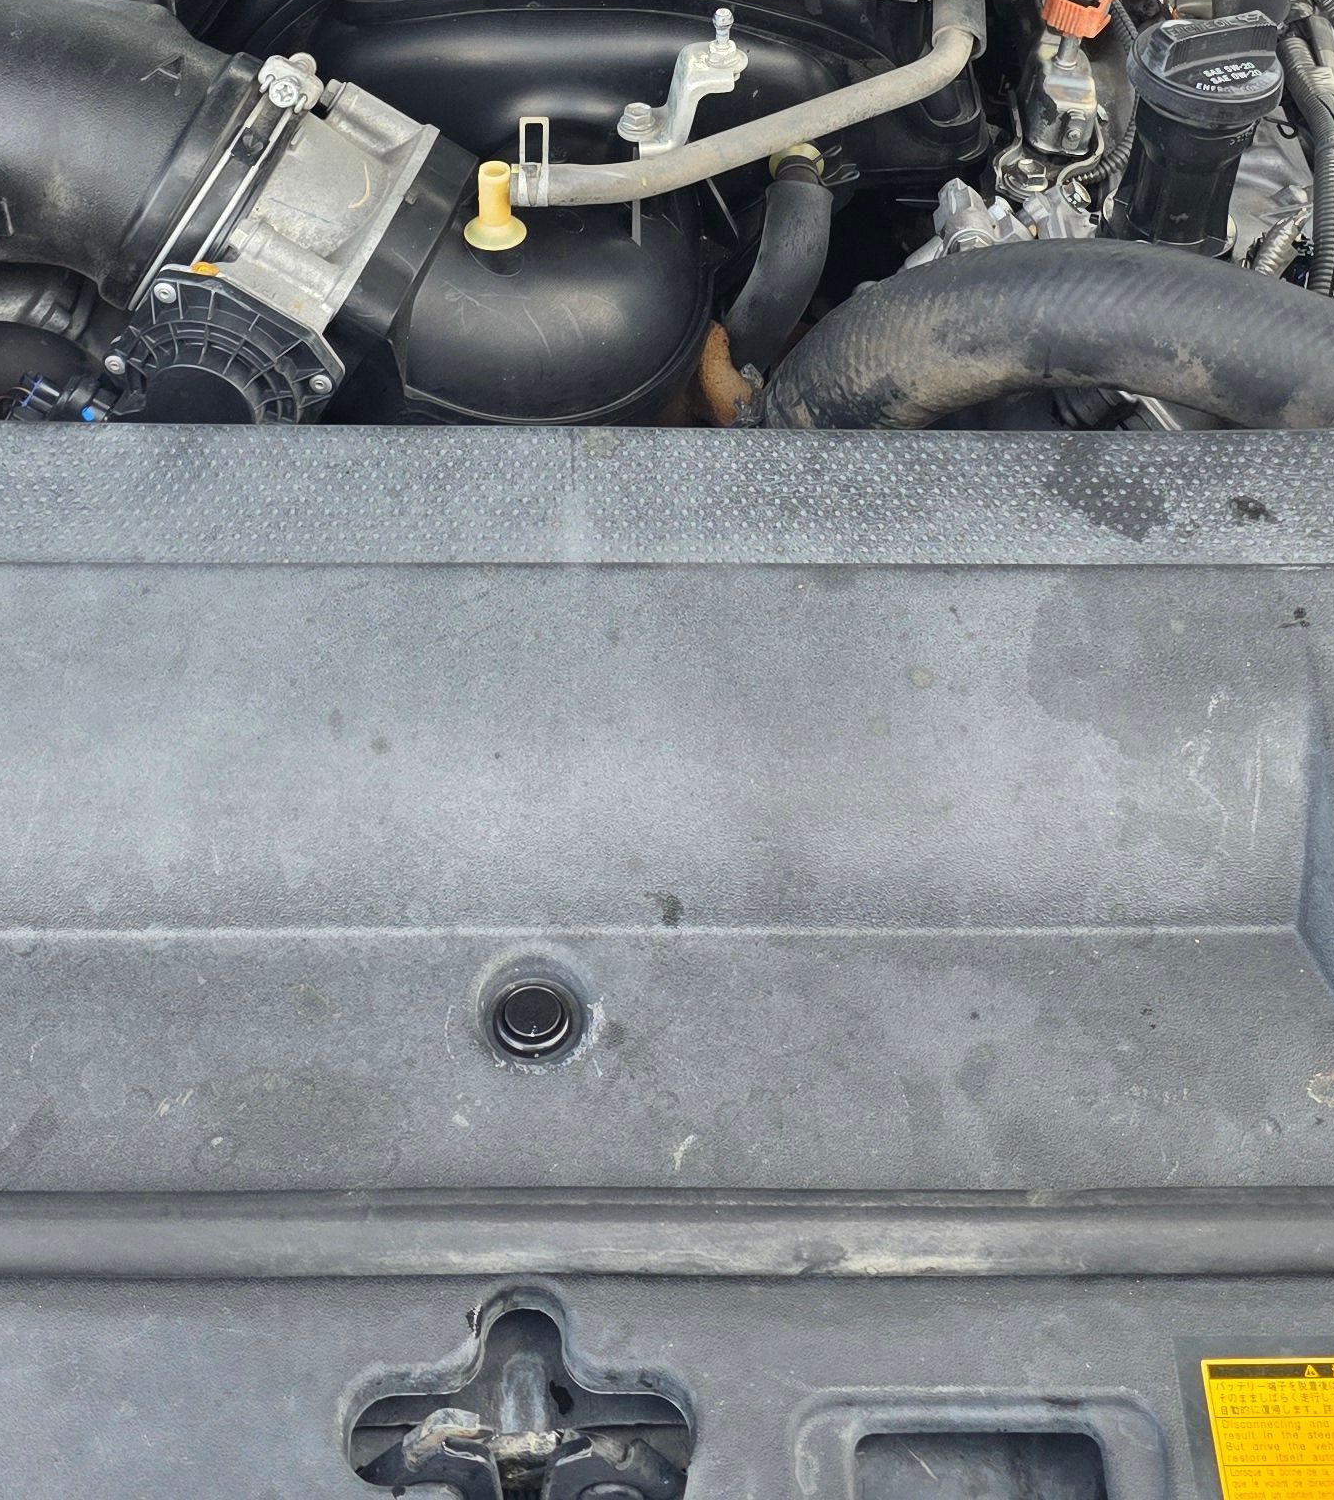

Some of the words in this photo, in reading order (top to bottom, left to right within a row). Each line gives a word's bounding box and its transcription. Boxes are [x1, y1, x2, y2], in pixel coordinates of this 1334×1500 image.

[1167, 23, 1215, 38] ENGINE
[1213, 18, 1237, 28] OIL
[1203, 67, 1225, 78] SAE
[1210, 74, 1232, 85] SAE
[1230, 69, 1263, 80] 0W-20
